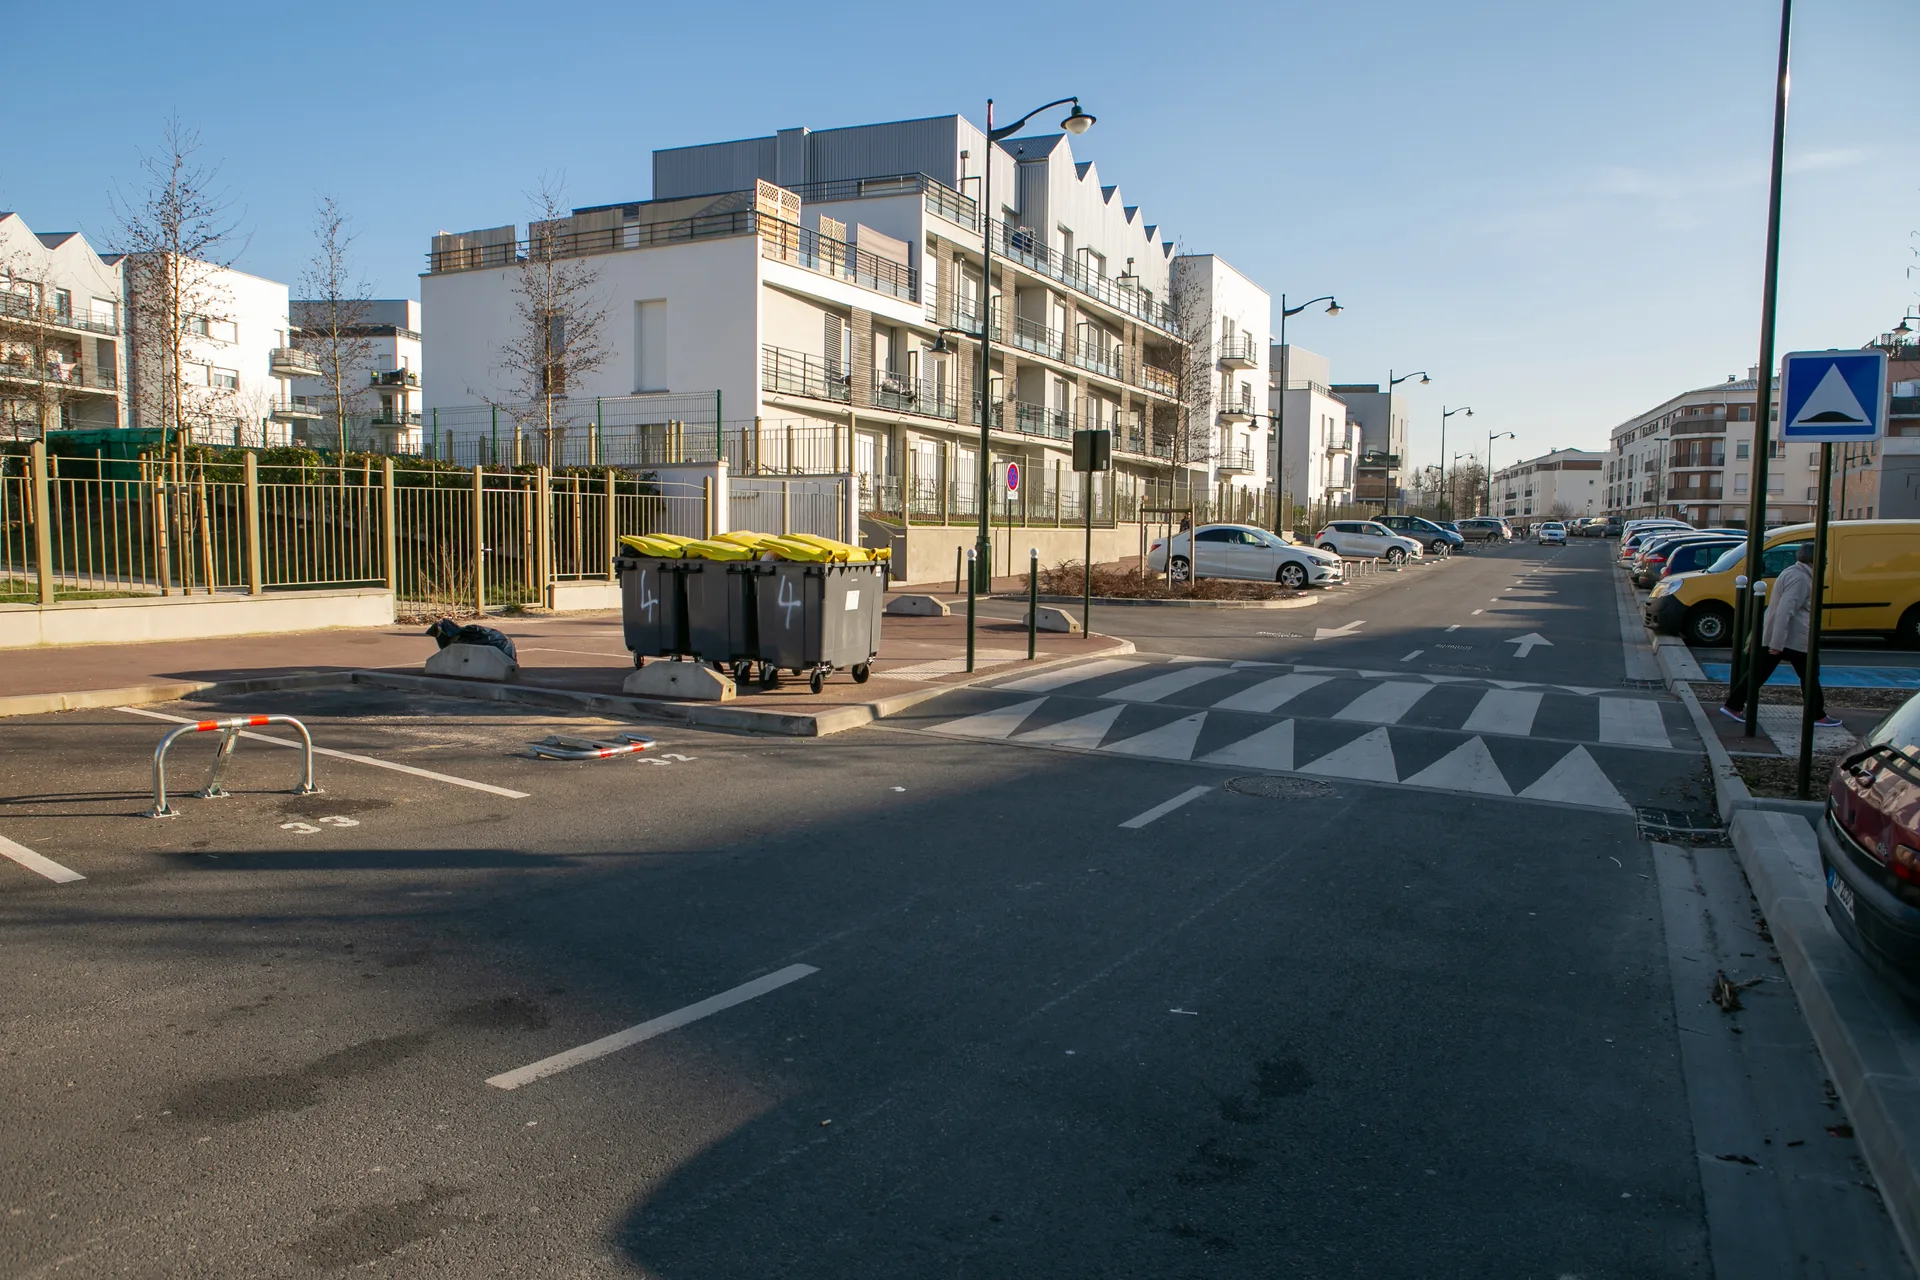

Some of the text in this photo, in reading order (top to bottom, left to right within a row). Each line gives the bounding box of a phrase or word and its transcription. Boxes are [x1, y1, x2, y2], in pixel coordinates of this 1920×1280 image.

[640, 570, 659, 623] 4
[778, 575, 801, 630] 4
[637, 753, 699, 766] 32
[280, 815, 360, 834] 33
